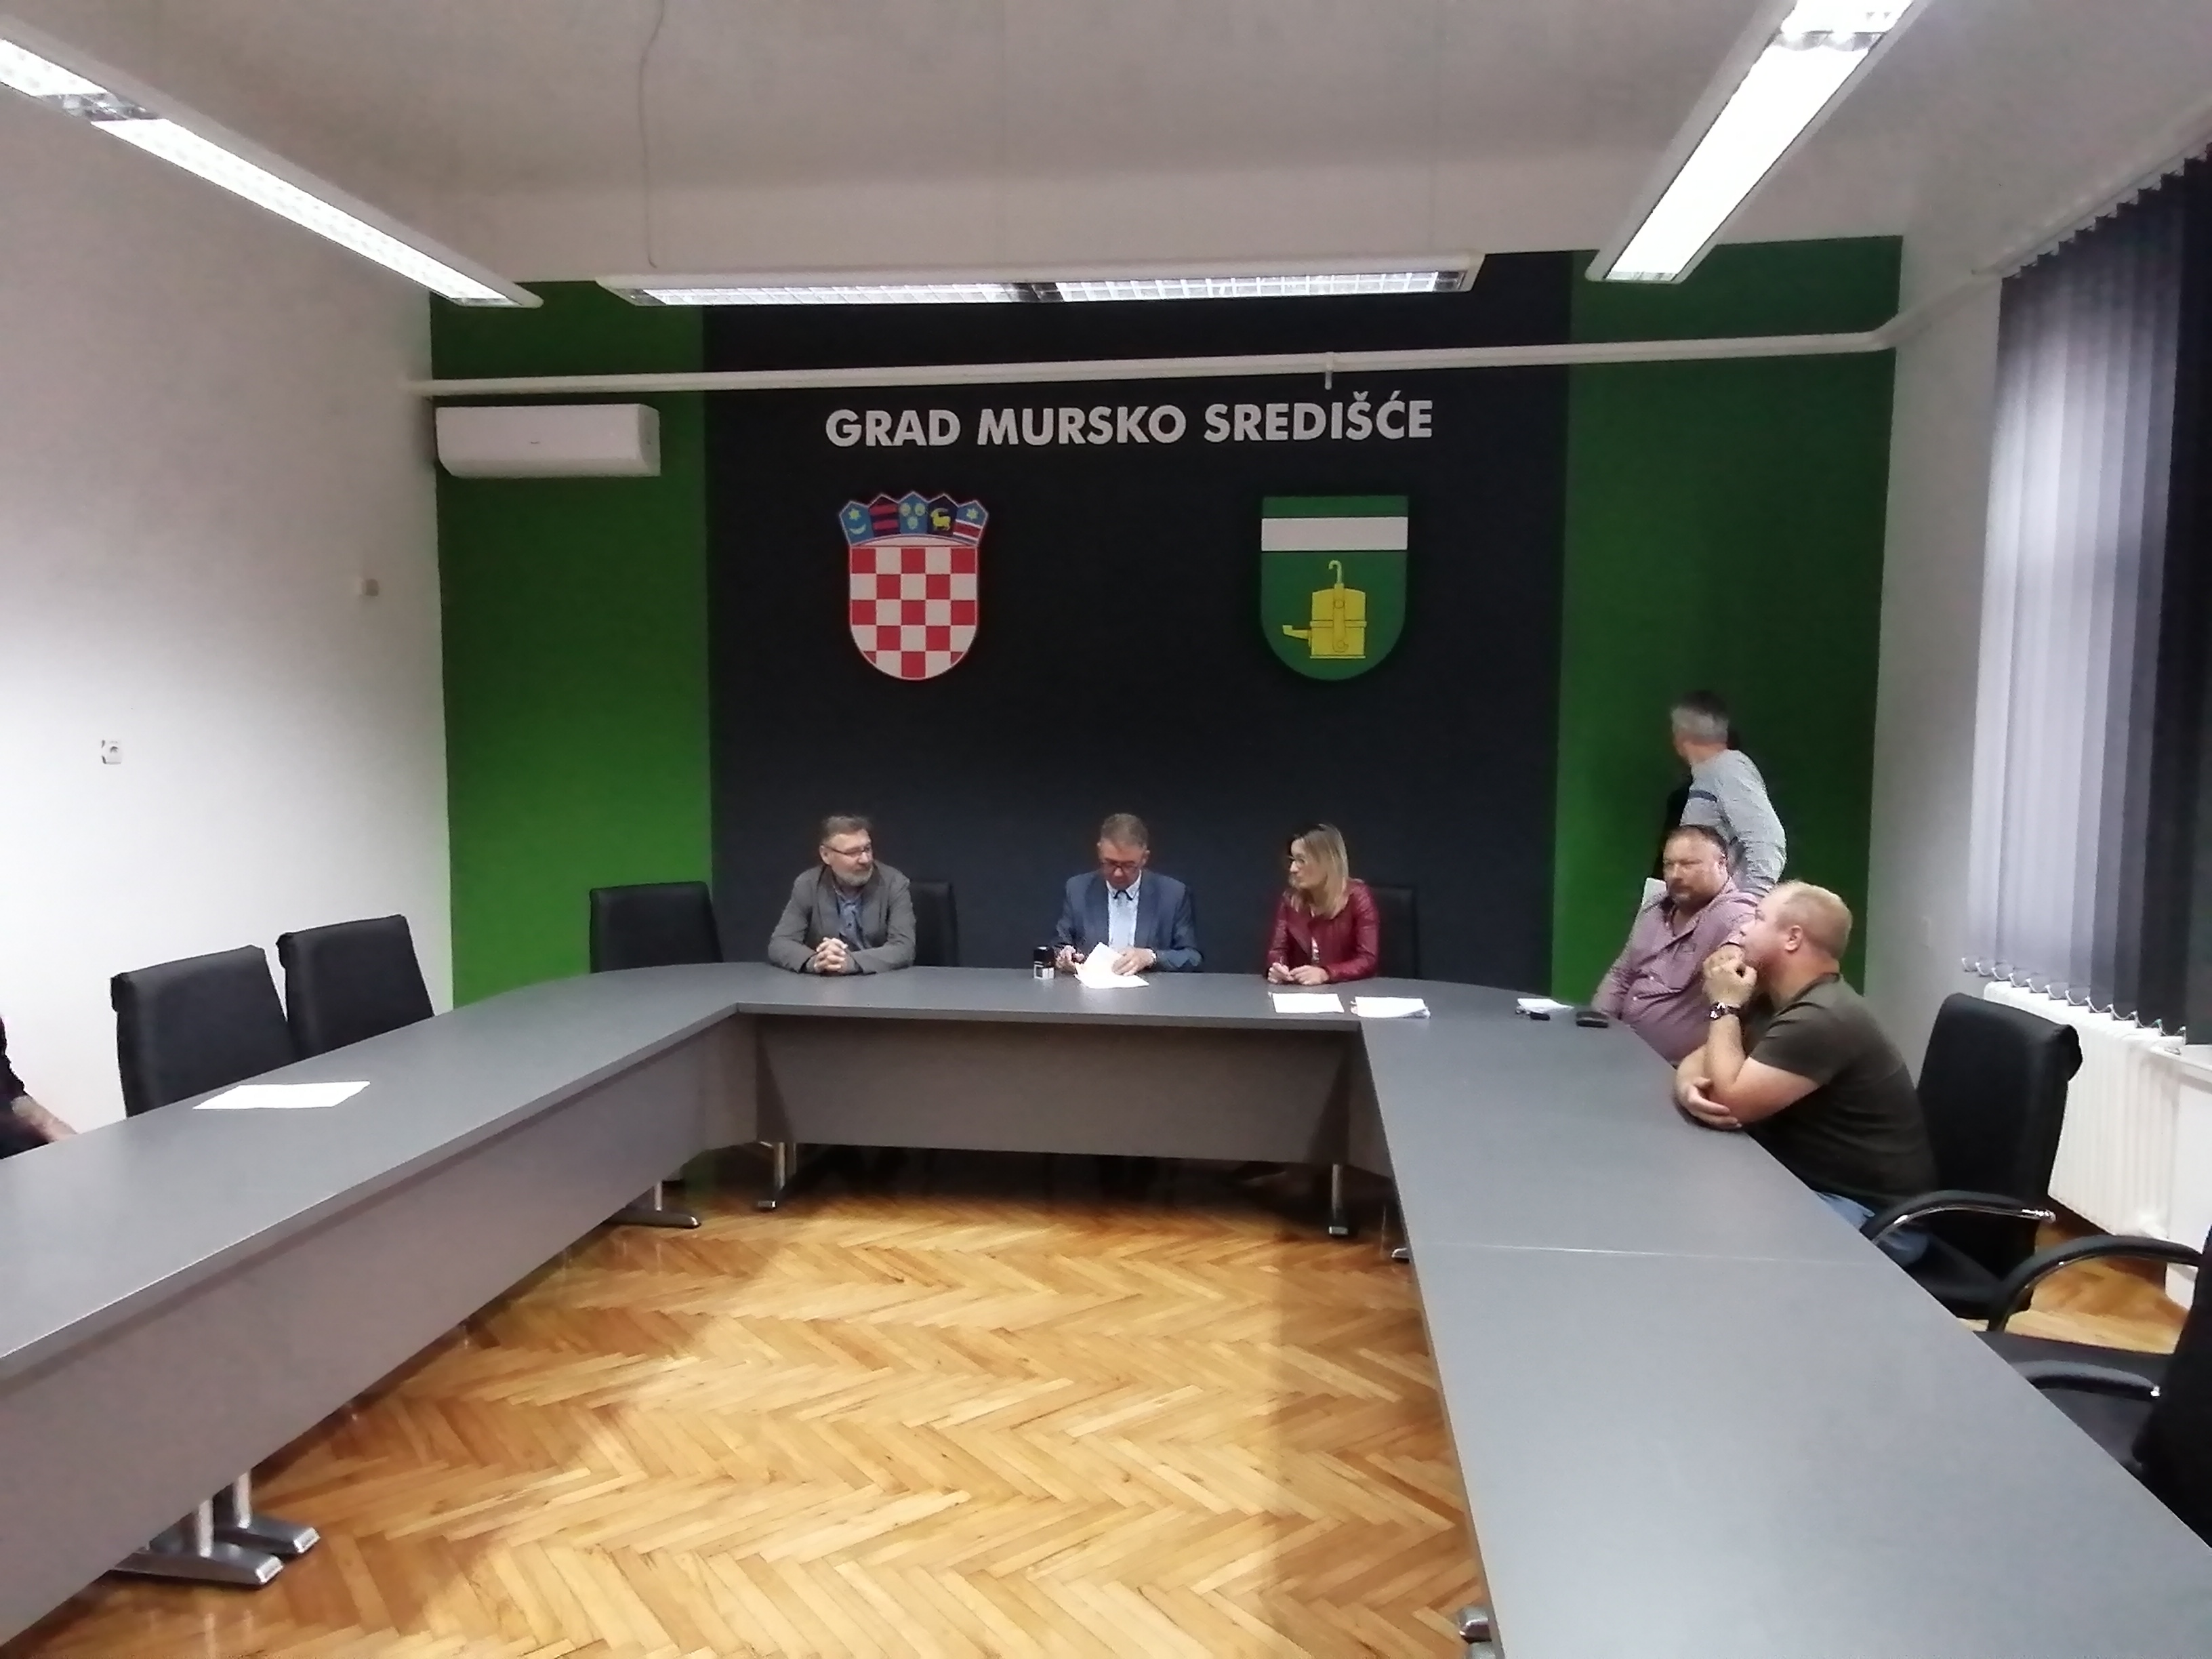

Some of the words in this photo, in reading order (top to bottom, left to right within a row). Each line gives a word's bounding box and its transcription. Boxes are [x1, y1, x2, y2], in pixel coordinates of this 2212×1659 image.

[825, 409, 961, 447] GRAD
[977, 404, 1187, 446] MURSKO
[1204, 390, 1433, 442] SREDIŠĆE
